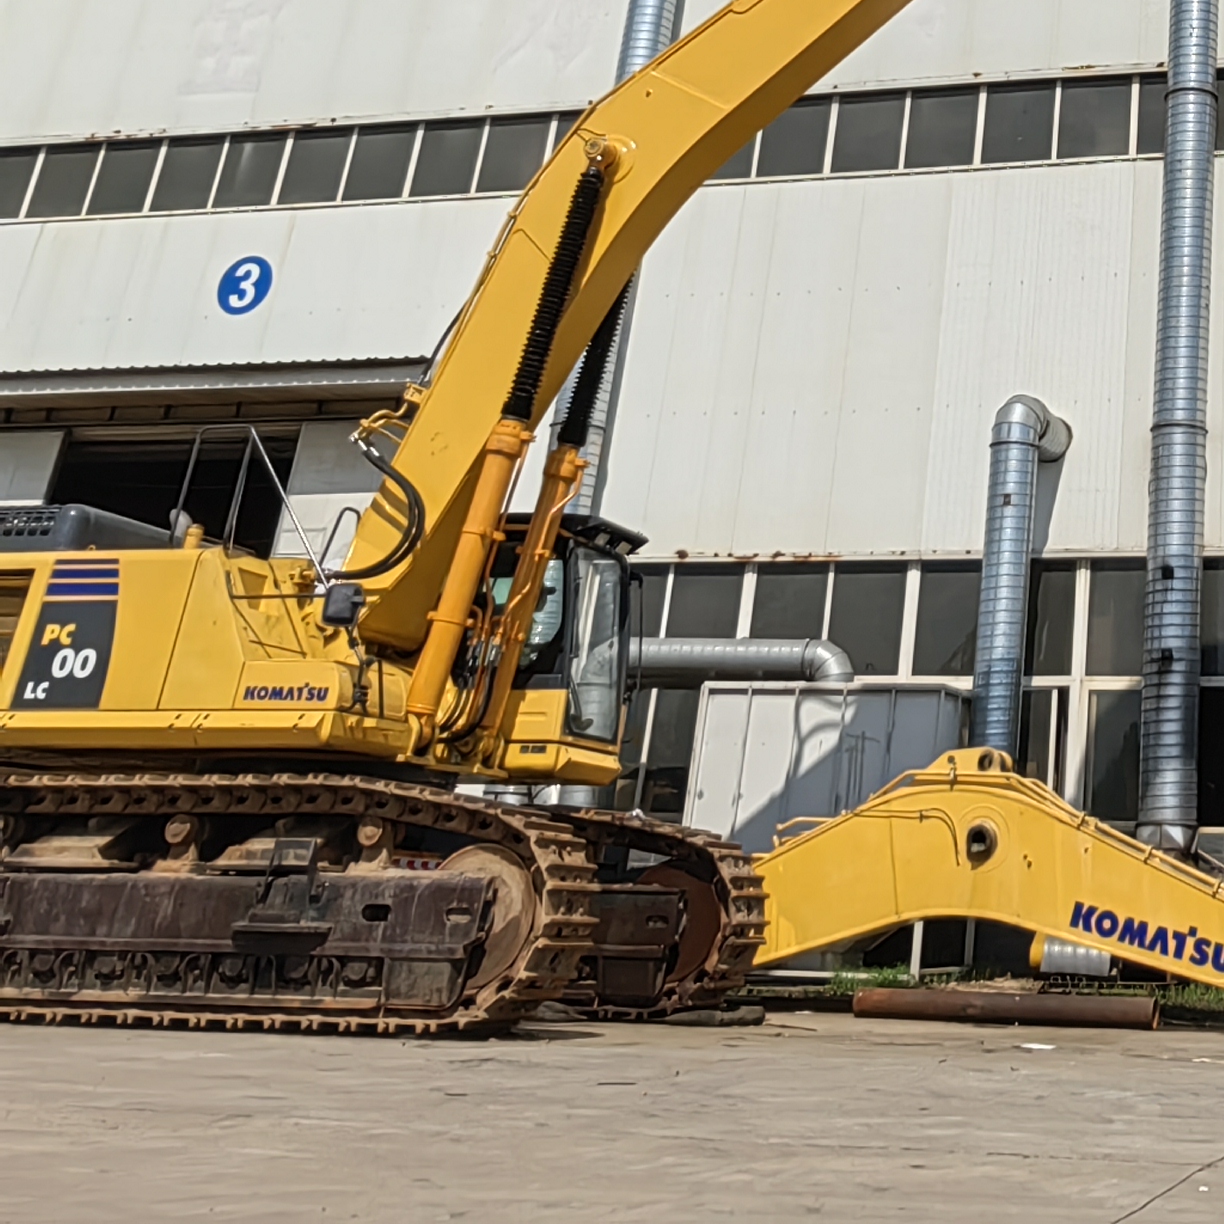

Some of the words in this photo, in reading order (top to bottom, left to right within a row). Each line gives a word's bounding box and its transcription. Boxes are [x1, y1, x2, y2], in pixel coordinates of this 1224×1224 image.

[228, 262, 261, 308] 3
[41, 623, 76, 646] PC
[51, 648, 97, 679] 00
[23, 681, 50, 700] LC
[243, 682, 329, 702] KOMATSU
